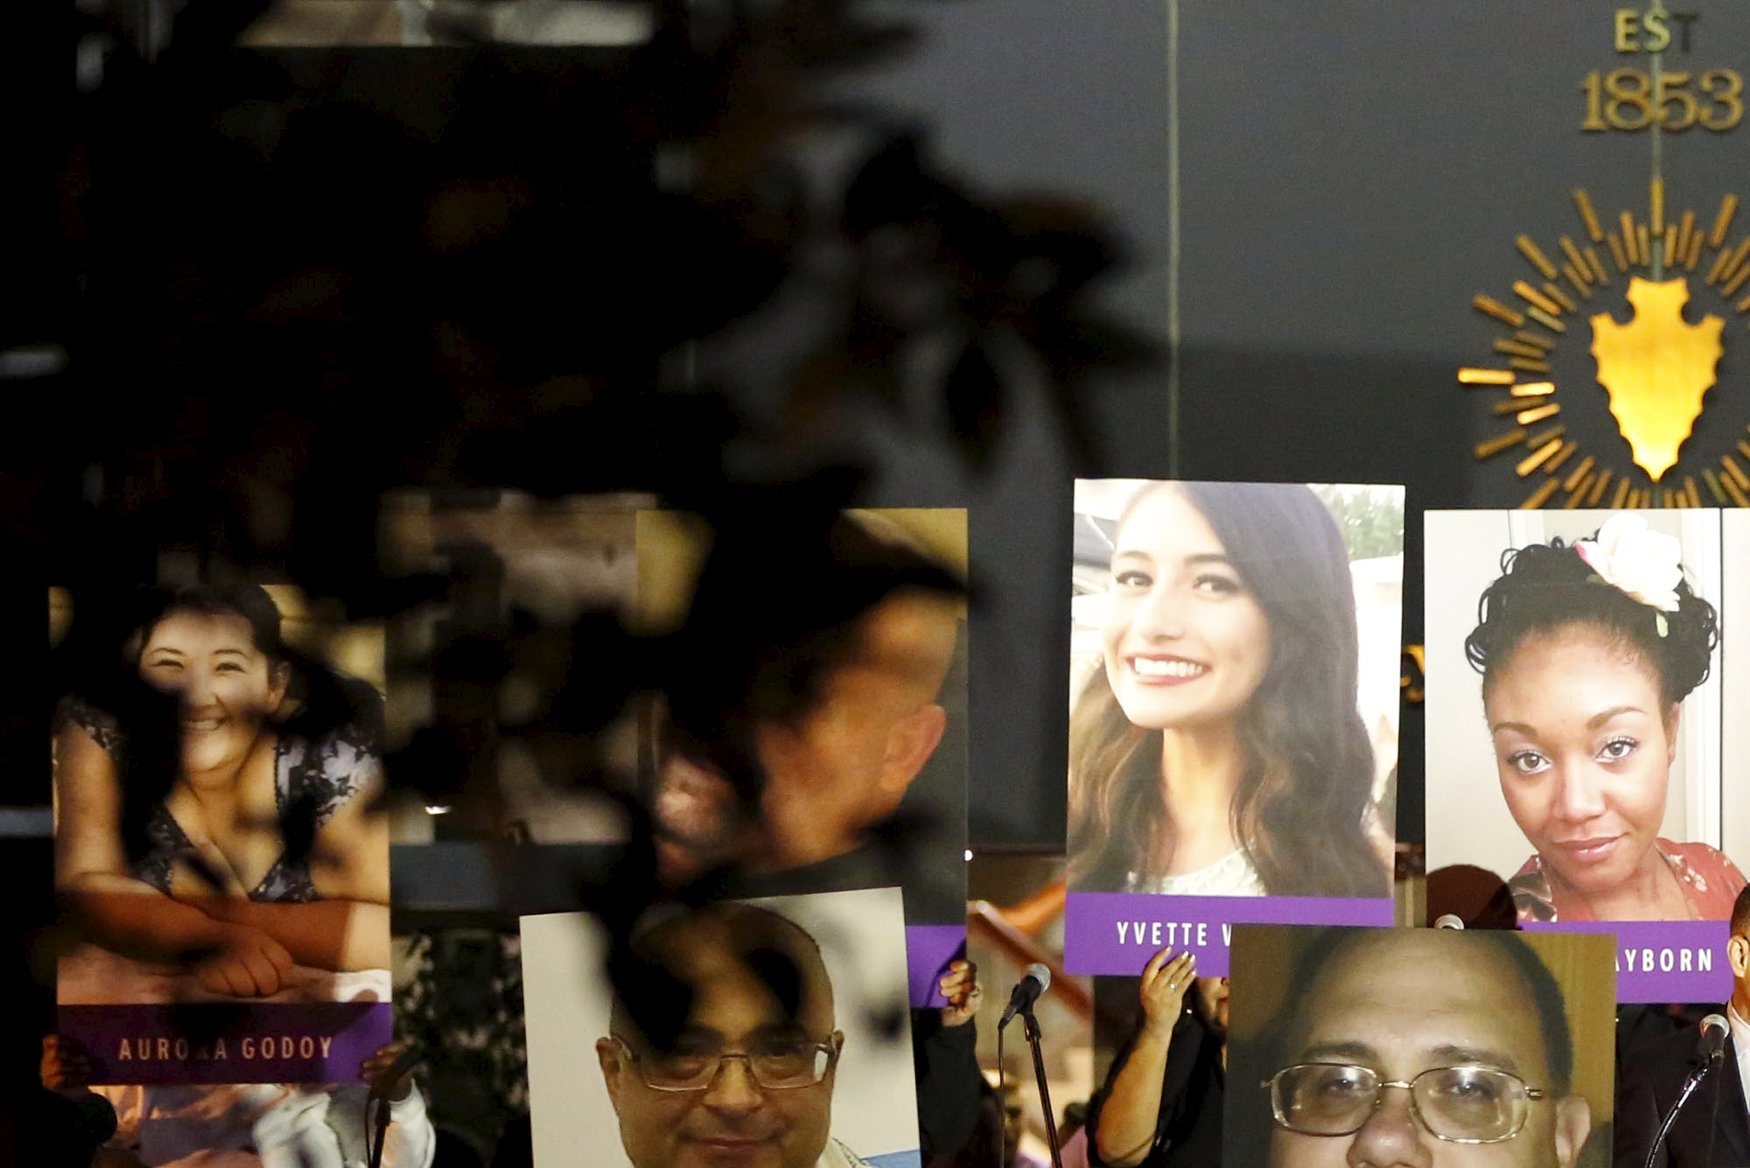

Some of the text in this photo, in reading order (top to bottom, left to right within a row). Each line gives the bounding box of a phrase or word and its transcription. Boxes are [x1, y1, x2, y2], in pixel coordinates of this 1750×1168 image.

[1614, 8, 1698, 52] EST
[1581, 67, 1744, 132] 1853
[1116, 921, 1207, 946] YVETTE
[241, 1036, 332, 1060] GODOY
